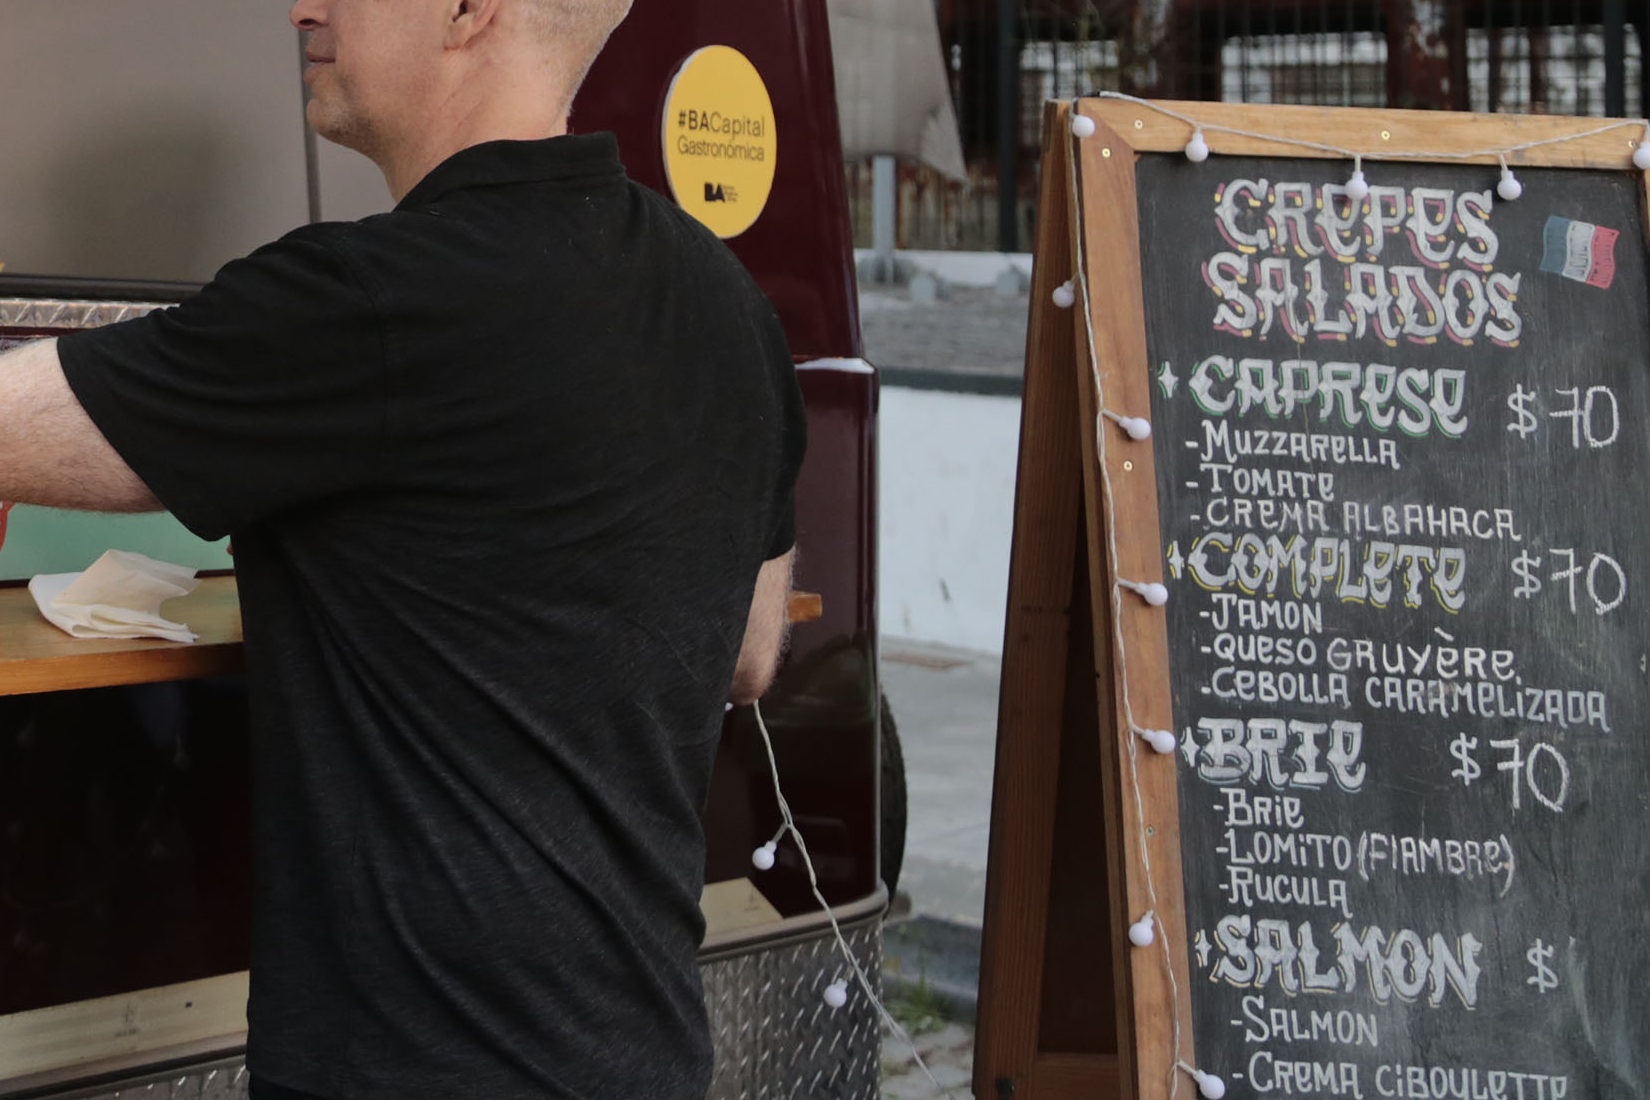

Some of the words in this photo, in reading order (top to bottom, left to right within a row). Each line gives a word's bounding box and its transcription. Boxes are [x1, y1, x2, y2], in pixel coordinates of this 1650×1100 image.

[678, 109, 765, 139] #BACapital
[678, 135, 765, 162] Gastronómica
[1213, 178, 1500, 271] CREPES
[1202, 251, 1522, 348] SALADOS
[1188, 354, 1469, 439] CAPRESE
[1343, 503, 1522, 542] ALBAHACA
[1188, 531, 1467, 615] COMPLETE
[1364, 674, 1612, 732] CARAMELIZADA
[1197, 716, 1367, 792] BRIE
[1209, 914, 1483, 1010] SALMON
[1527, 938, 1560, 994] $
